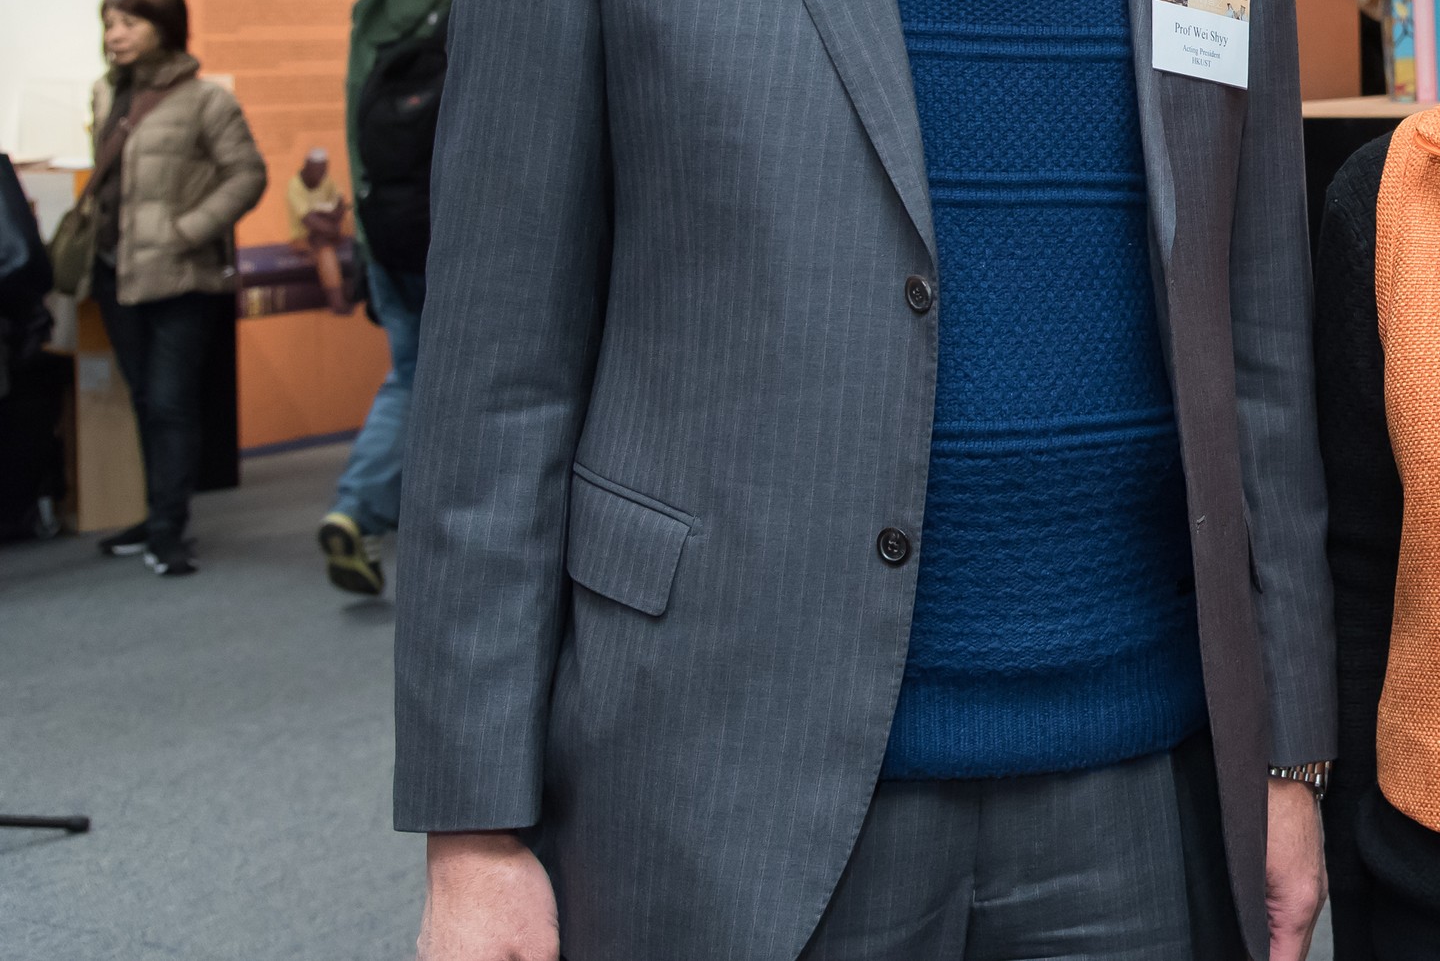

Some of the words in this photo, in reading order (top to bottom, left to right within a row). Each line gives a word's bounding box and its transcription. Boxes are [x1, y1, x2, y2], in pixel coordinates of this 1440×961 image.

[1174, 22, 1192, 37] Prof
[1193, 26, 1208, 40] Wei
[1210, 30, 1228, 47] Shyy
[1182, 44, 1199, 56] Acting
[1199, 47, 1221, 59] President
[1191, 57, 1211, 68] HKUST
